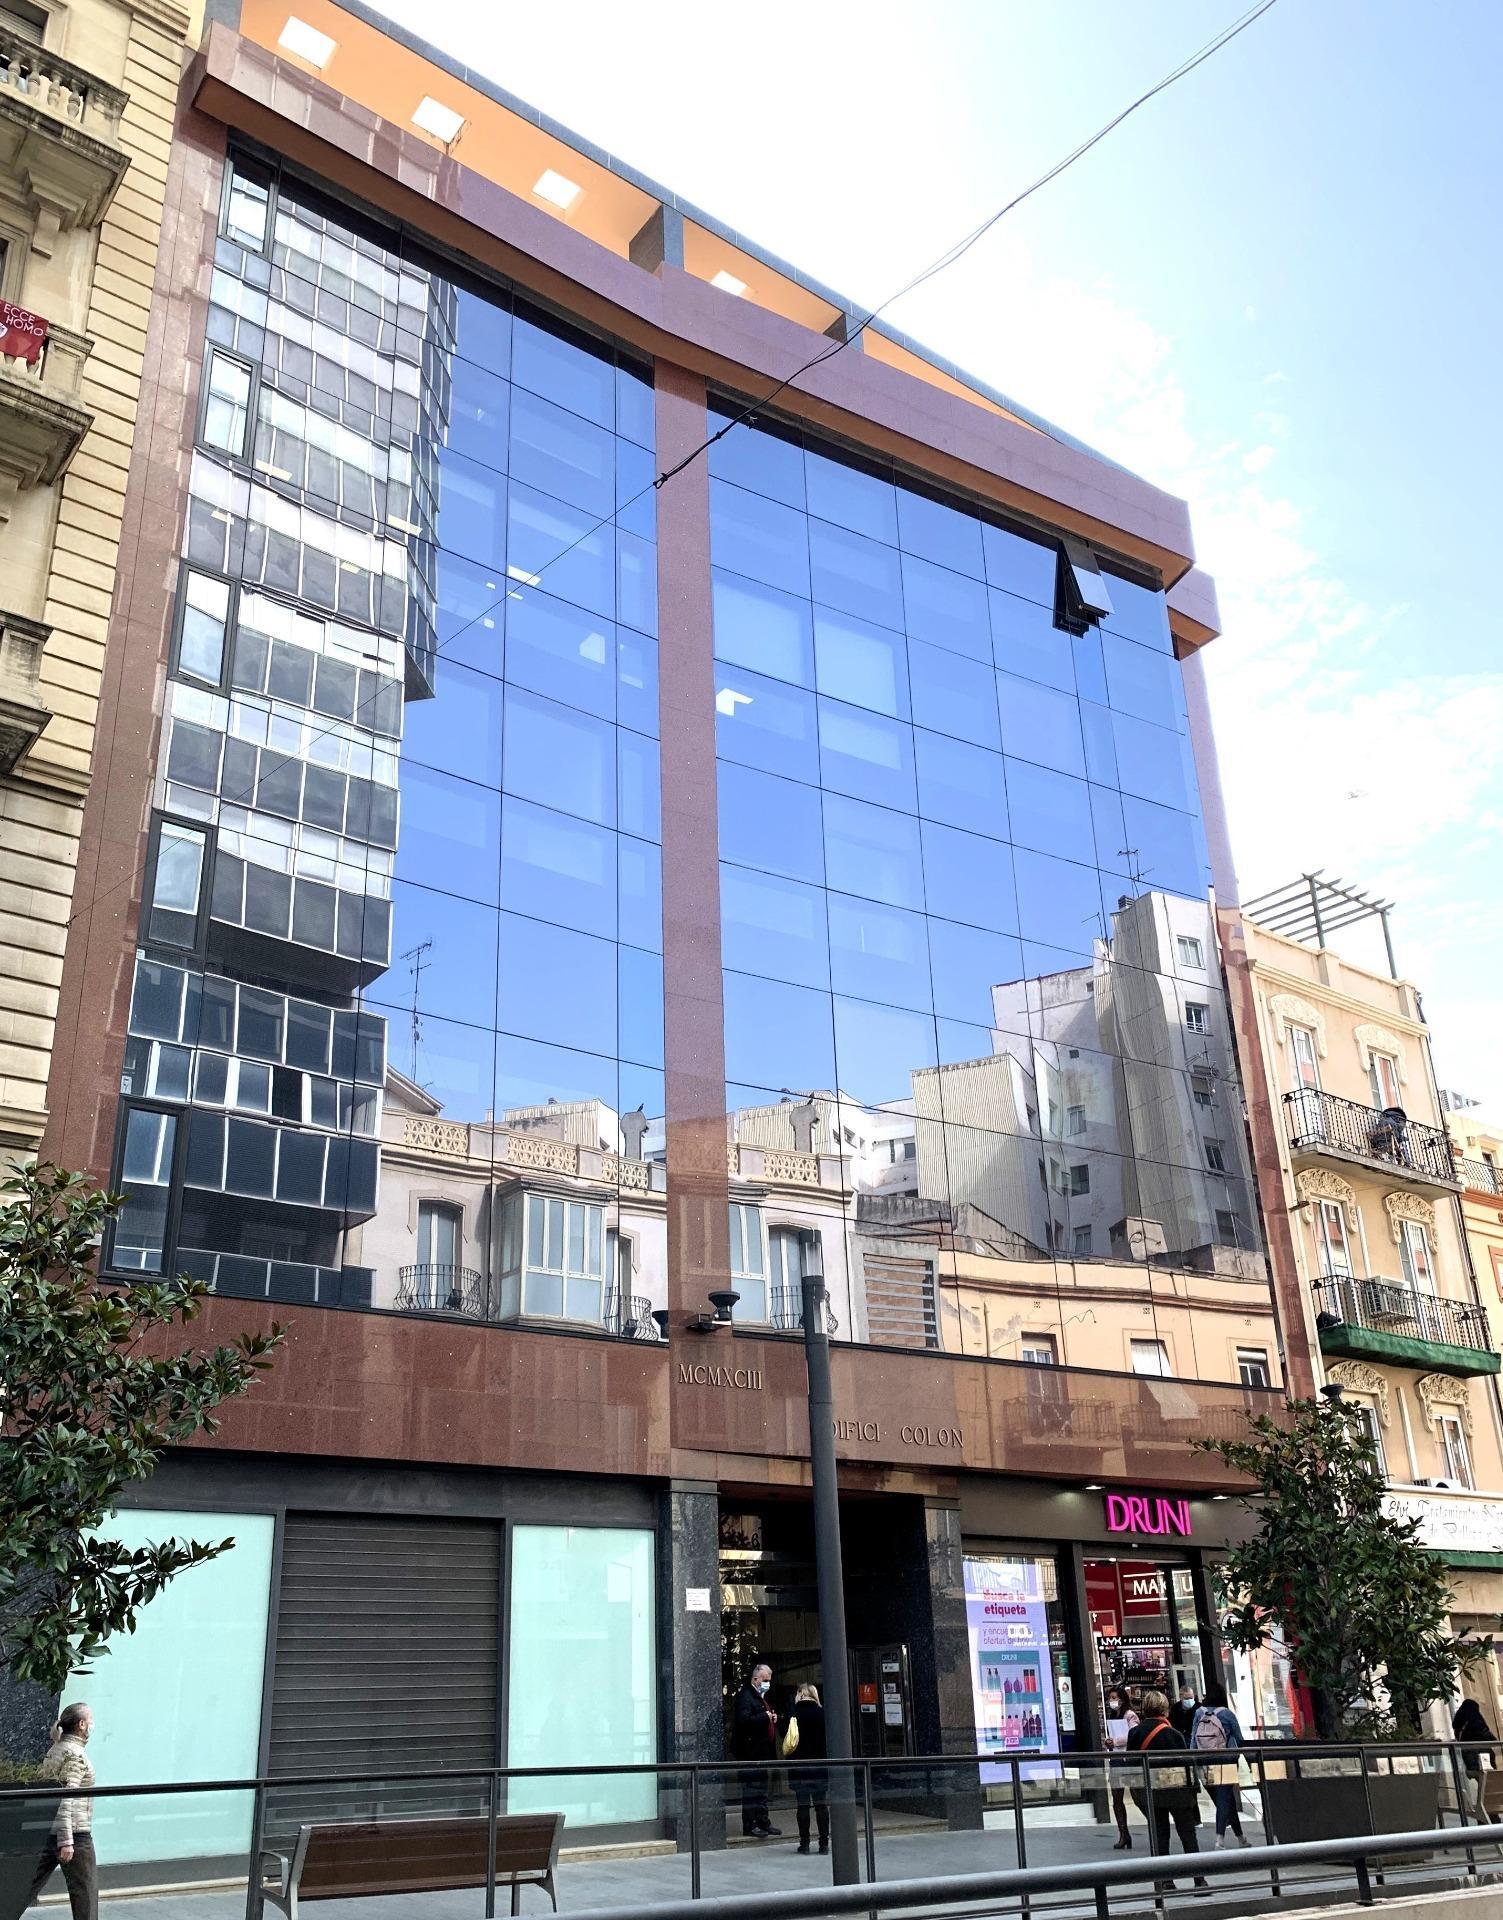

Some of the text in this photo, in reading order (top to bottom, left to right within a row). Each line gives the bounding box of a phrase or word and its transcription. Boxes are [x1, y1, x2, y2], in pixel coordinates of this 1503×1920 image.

[4, 303, 36, 325] ECCE
[6, 314, 44, 336] HOMO
[679, 1363, 763, 1390] MCMXCIII
[833, 1419, 964, 1448] IFICI COLON
[1106, 1495, 1193, 1536] DRUNI
[1133, 1578, 1167, 1596] MAK
[984, 1602, 1027, 1618] etiqueta
[1101, 1636, 1122, 1646] NYX
[1128, 1635, 1172, 1644] PROFESSION
